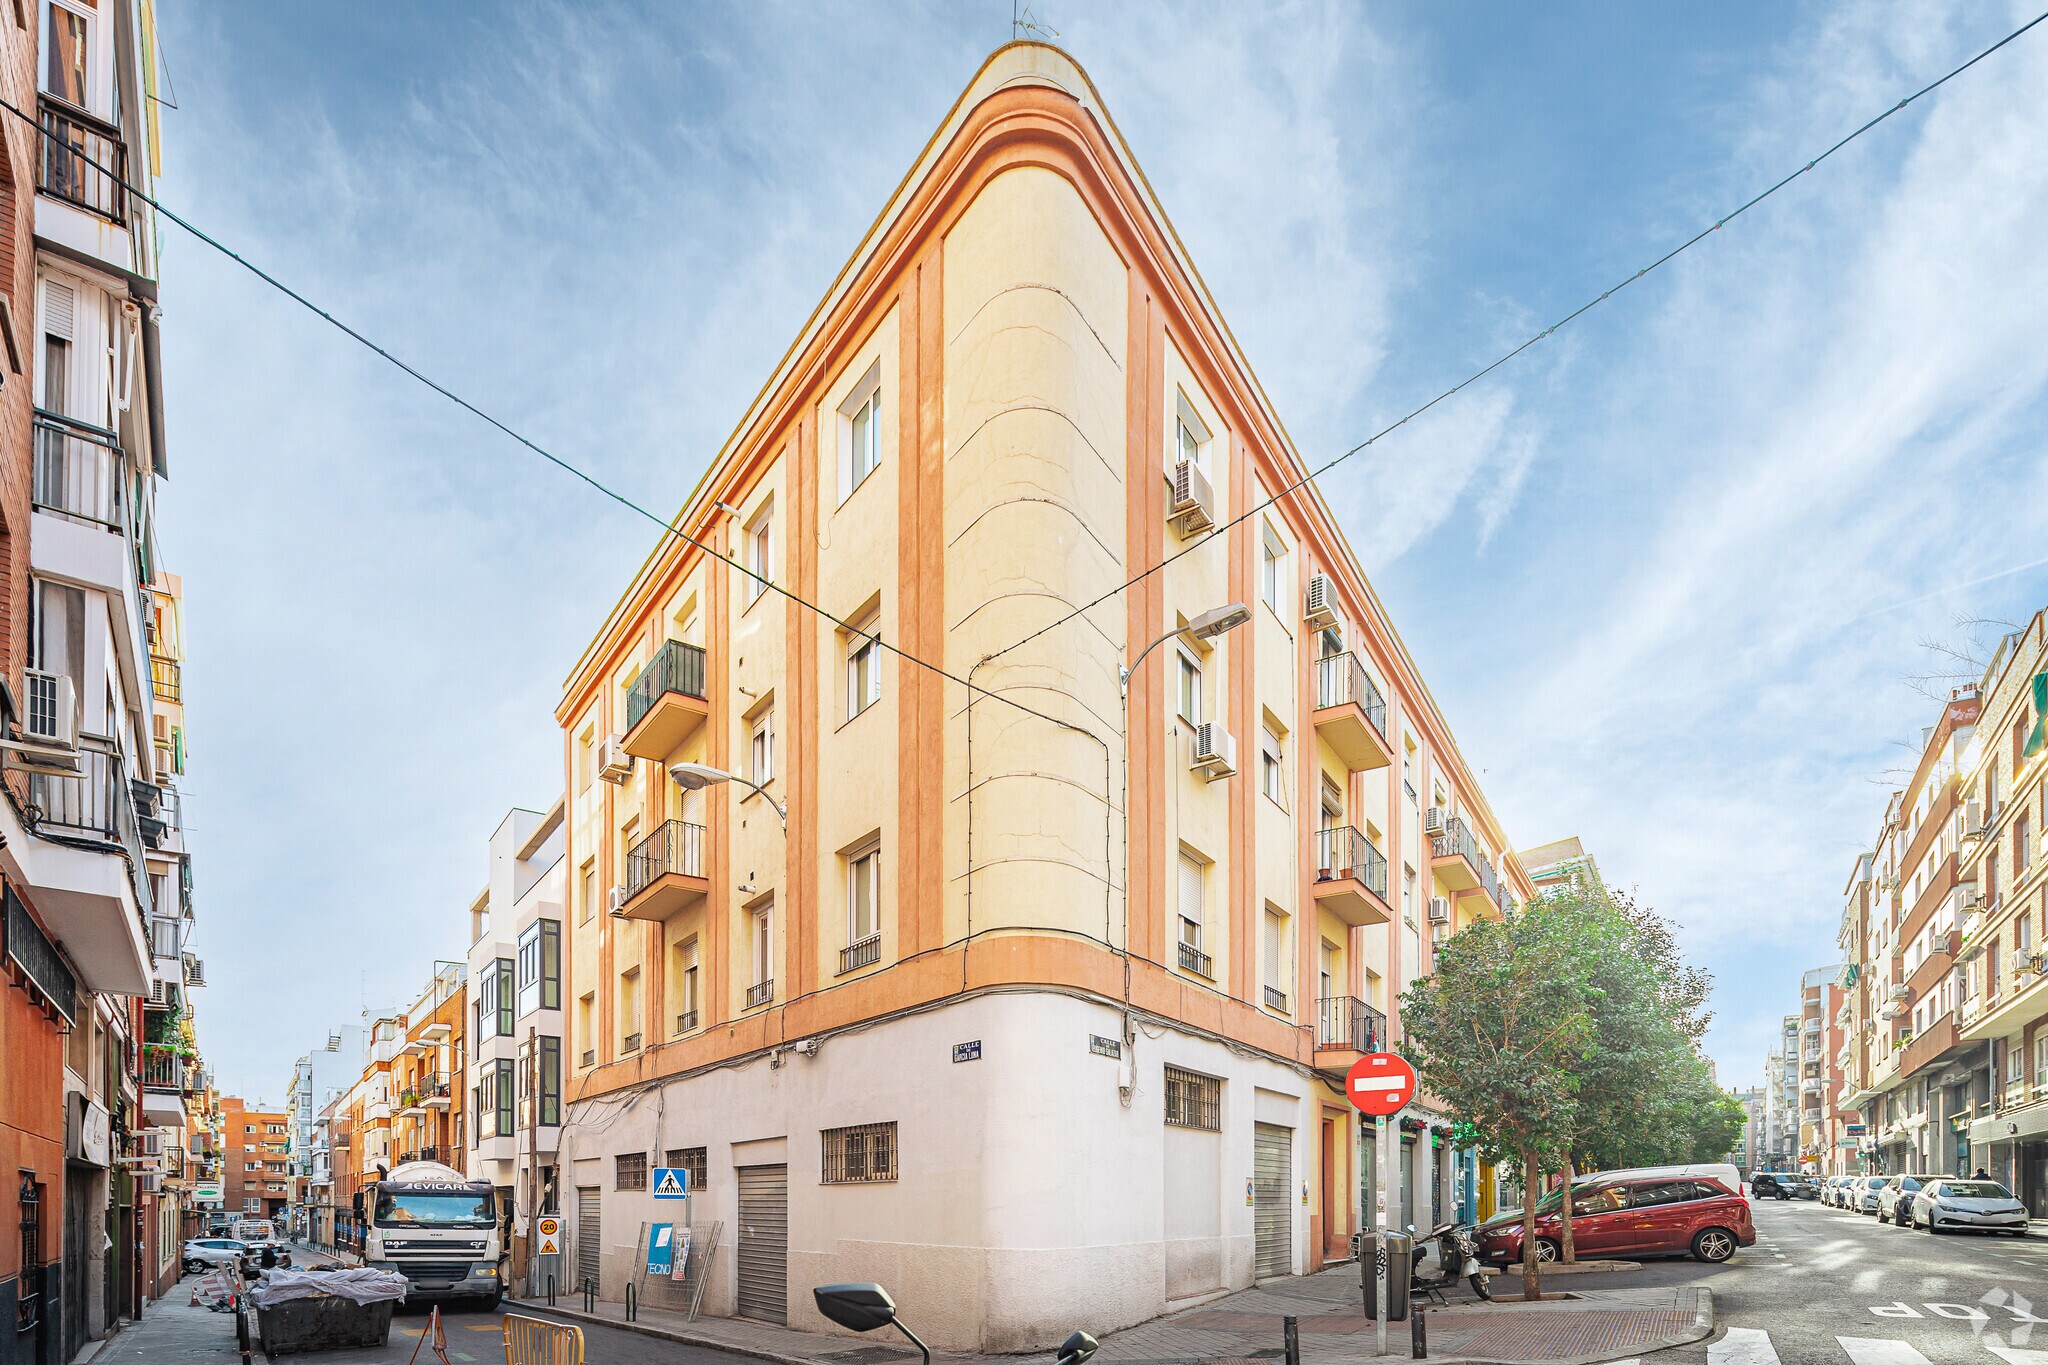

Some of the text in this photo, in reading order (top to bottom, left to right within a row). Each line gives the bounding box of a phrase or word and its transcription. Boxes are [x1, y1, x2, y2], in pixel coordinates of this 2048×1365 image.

[959, 1041, 980, 1050] CALLE
[1101, 1038, 1116, 1046] CALLE
[968, 1050, 979, 1060] LUNA
